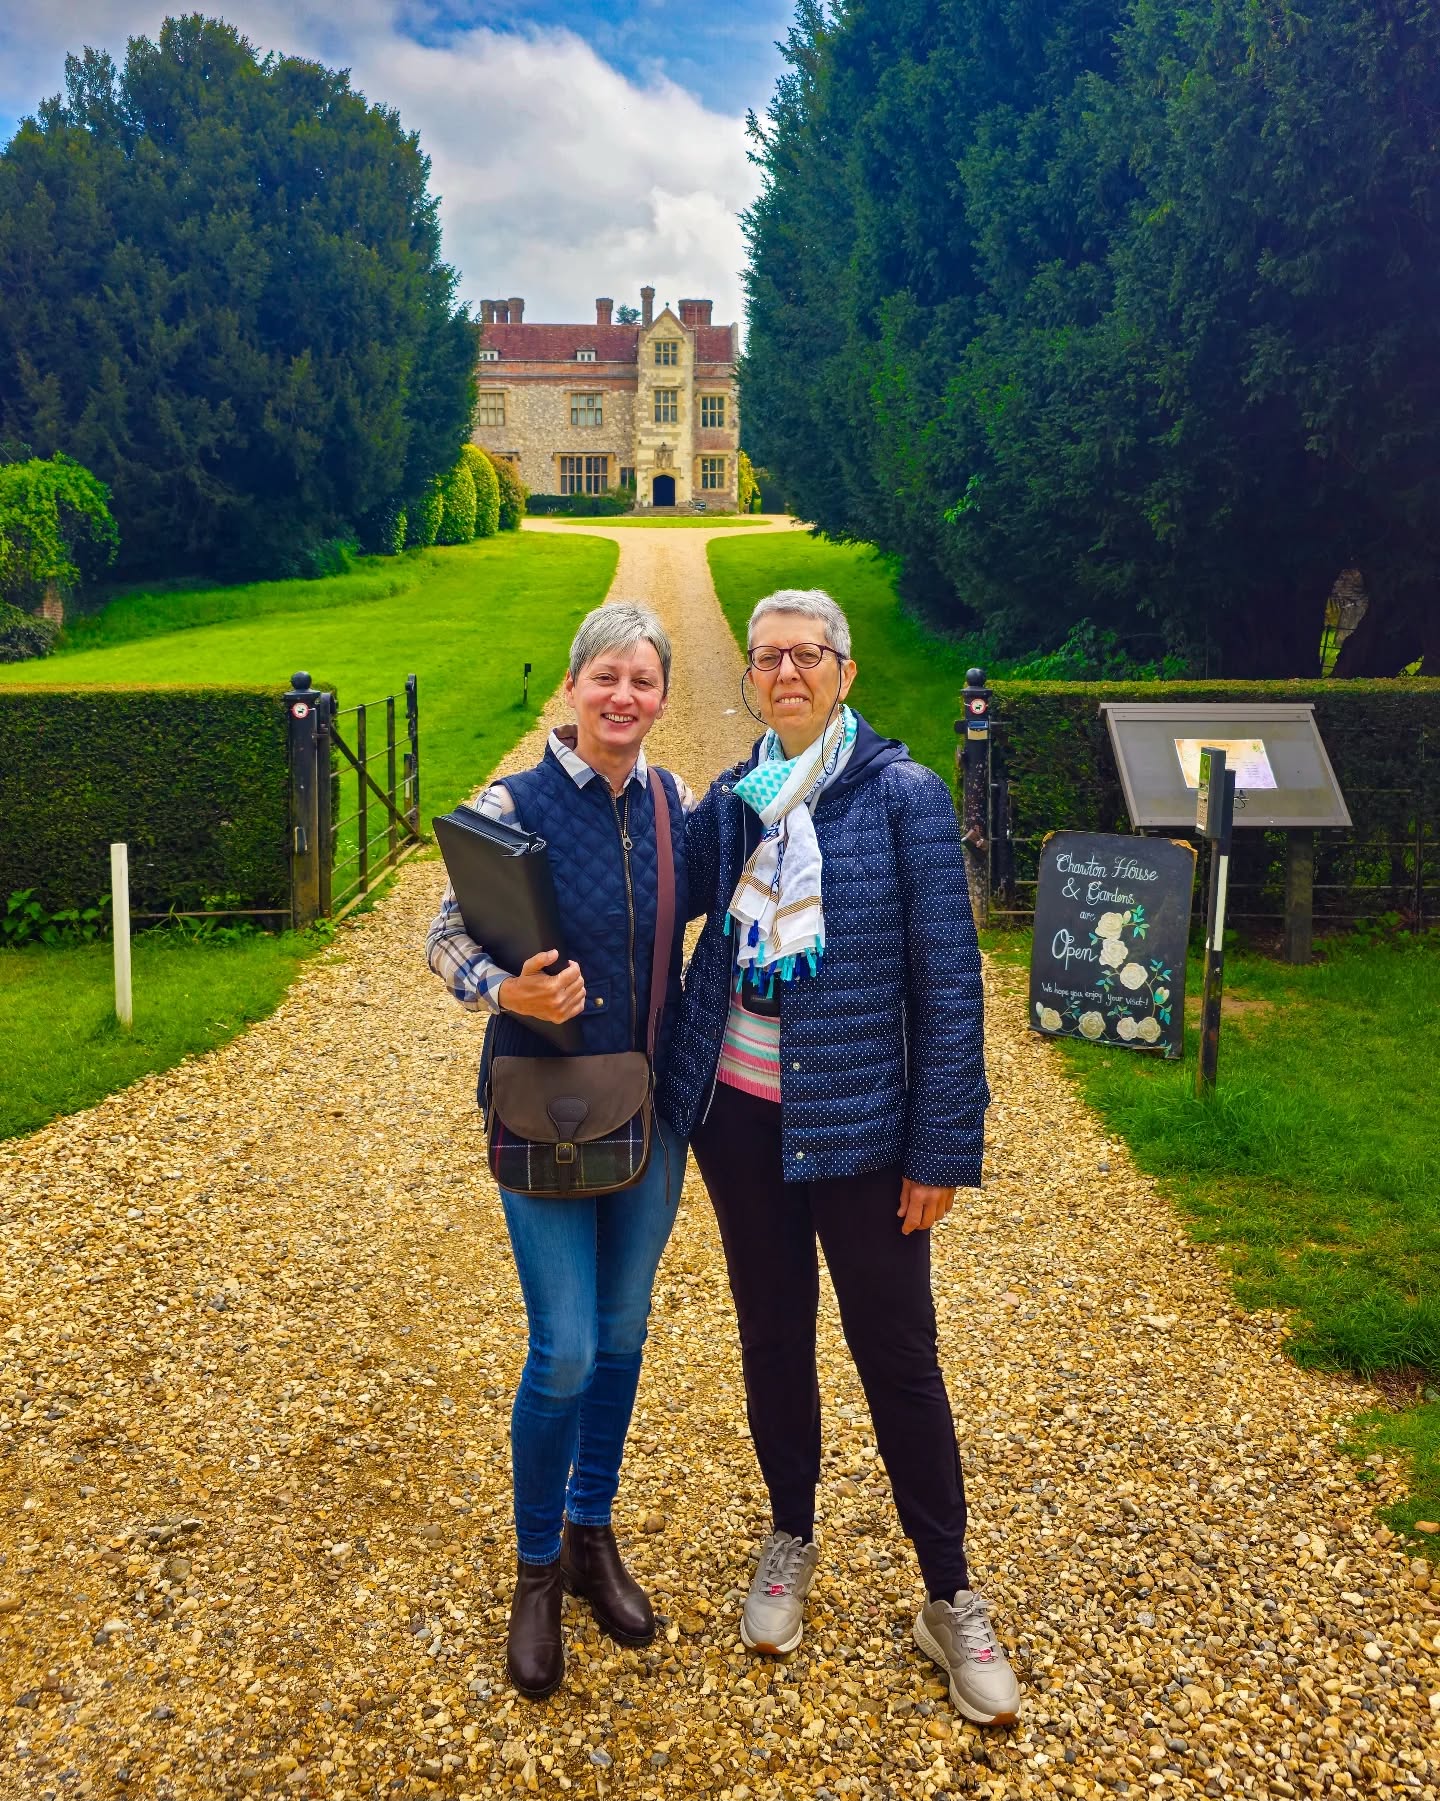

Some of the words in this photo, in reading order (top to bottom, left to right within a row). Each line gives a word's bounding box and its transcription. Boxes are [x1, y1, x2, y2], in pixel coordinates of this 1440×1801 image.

[1056, 852, 1107, 878] Chawton
[1112, 856, 1158, 880] House
[1062, 877, 1080, 900] &
[1086, 881, 1135, 905] Gardens
[1079, 911, 1096, 921] are
[1052, 929, 1098, 970] Open
[1041, 982, 1053, 993] We
[1053, 982, 1069, 997] hope
[1070, 990, 1084, 1000] you
[1084, 990, 1103, 1003] enjoy
